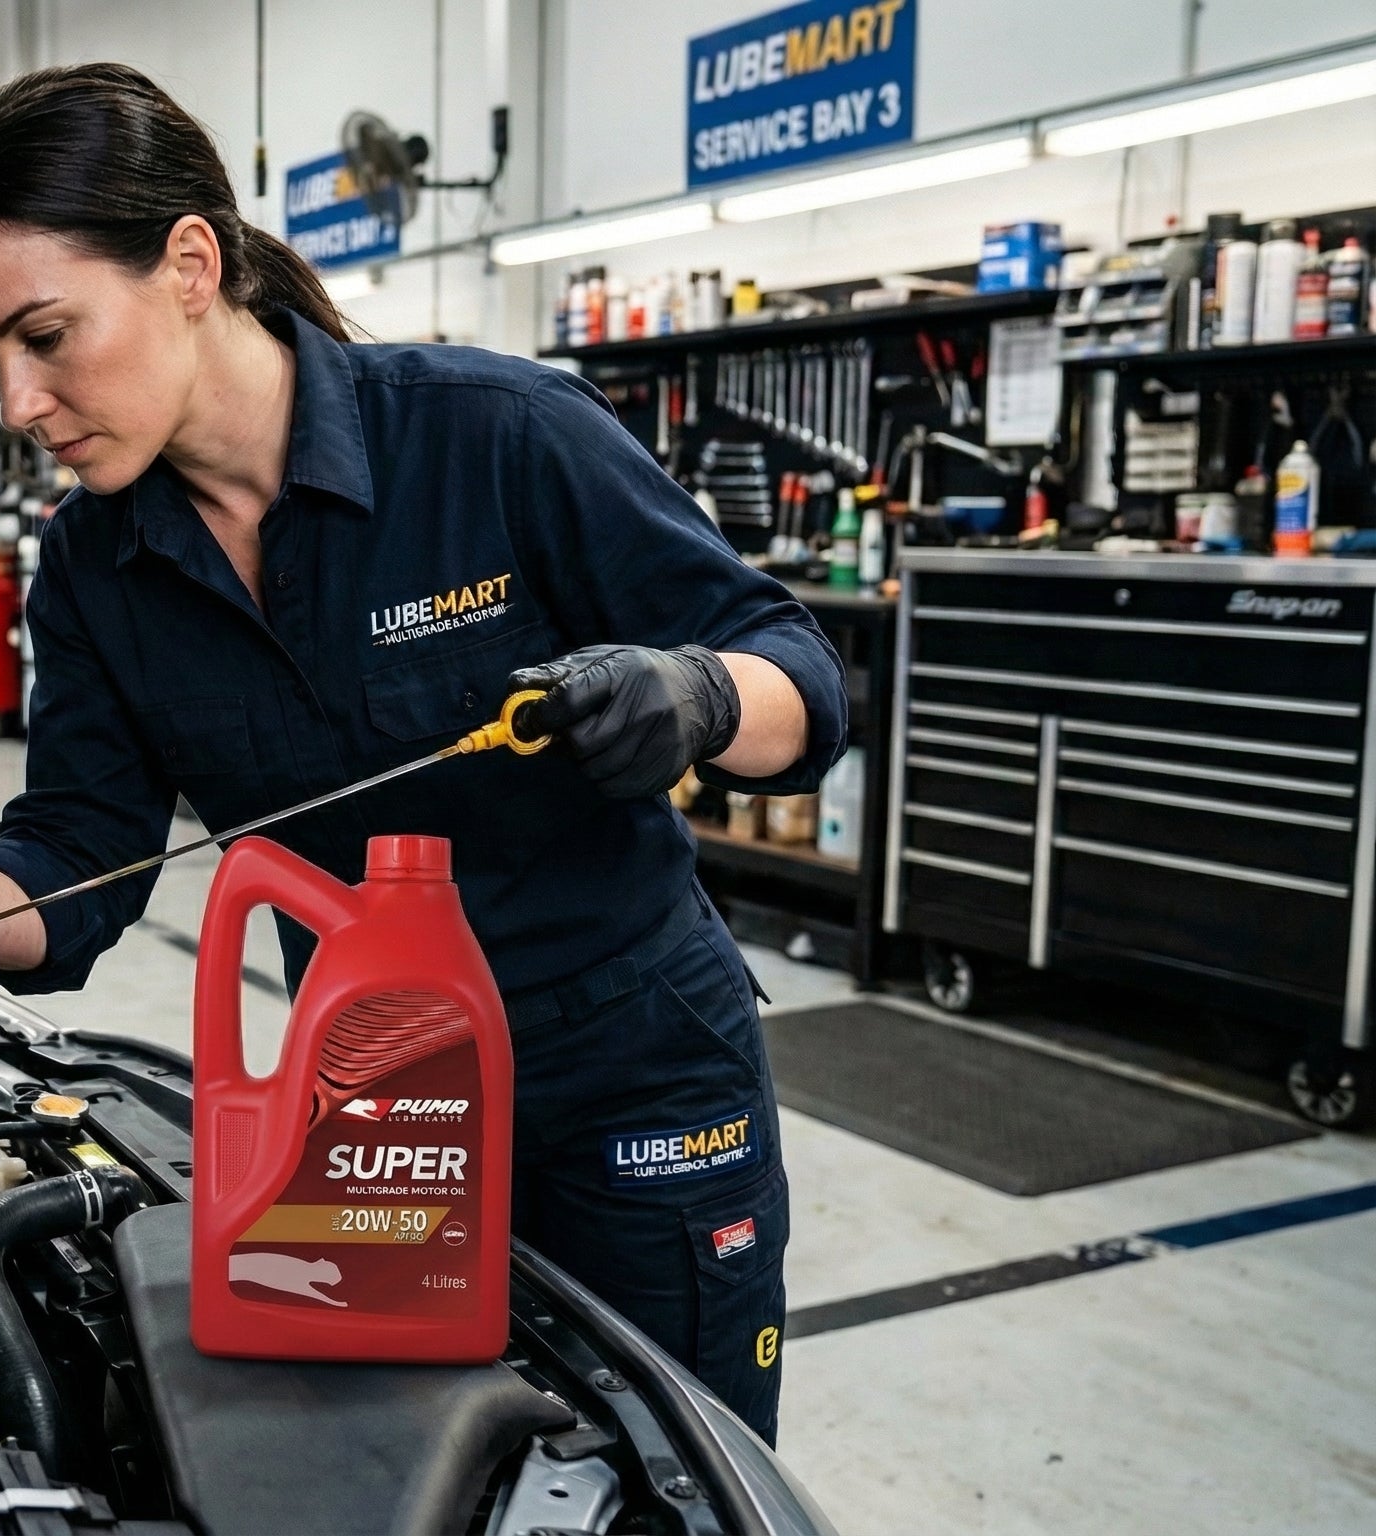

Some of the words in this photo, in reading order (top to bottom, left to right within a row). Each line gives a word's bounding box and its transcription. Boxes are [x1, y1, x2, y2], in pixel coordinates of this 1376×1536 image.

[694, 0, 905, 103] LUBEMART
[693, 104, 809, 171] SERVICE
[812, 87, 873, 143] BAY
[877, 81, 902, 128] 3
[370, 573, 512, 636] LUBEMART
[389, 1098, 470, 1115] PUMA
[616, 1118, 750, 1166] LUBEMART
[325, 1144, 468, 1180] SUPER
[346, 1186, 409, 1195] MULTIGRADE
[411, 1187, 446, 1195] MOTOR
[450, 1187, 467, 1196] OIL
[341, 1208, 428, 1232] 20W-50
[422, 1274, 430, 1288] 4
[433, 1274, 467, 1289] Litres
